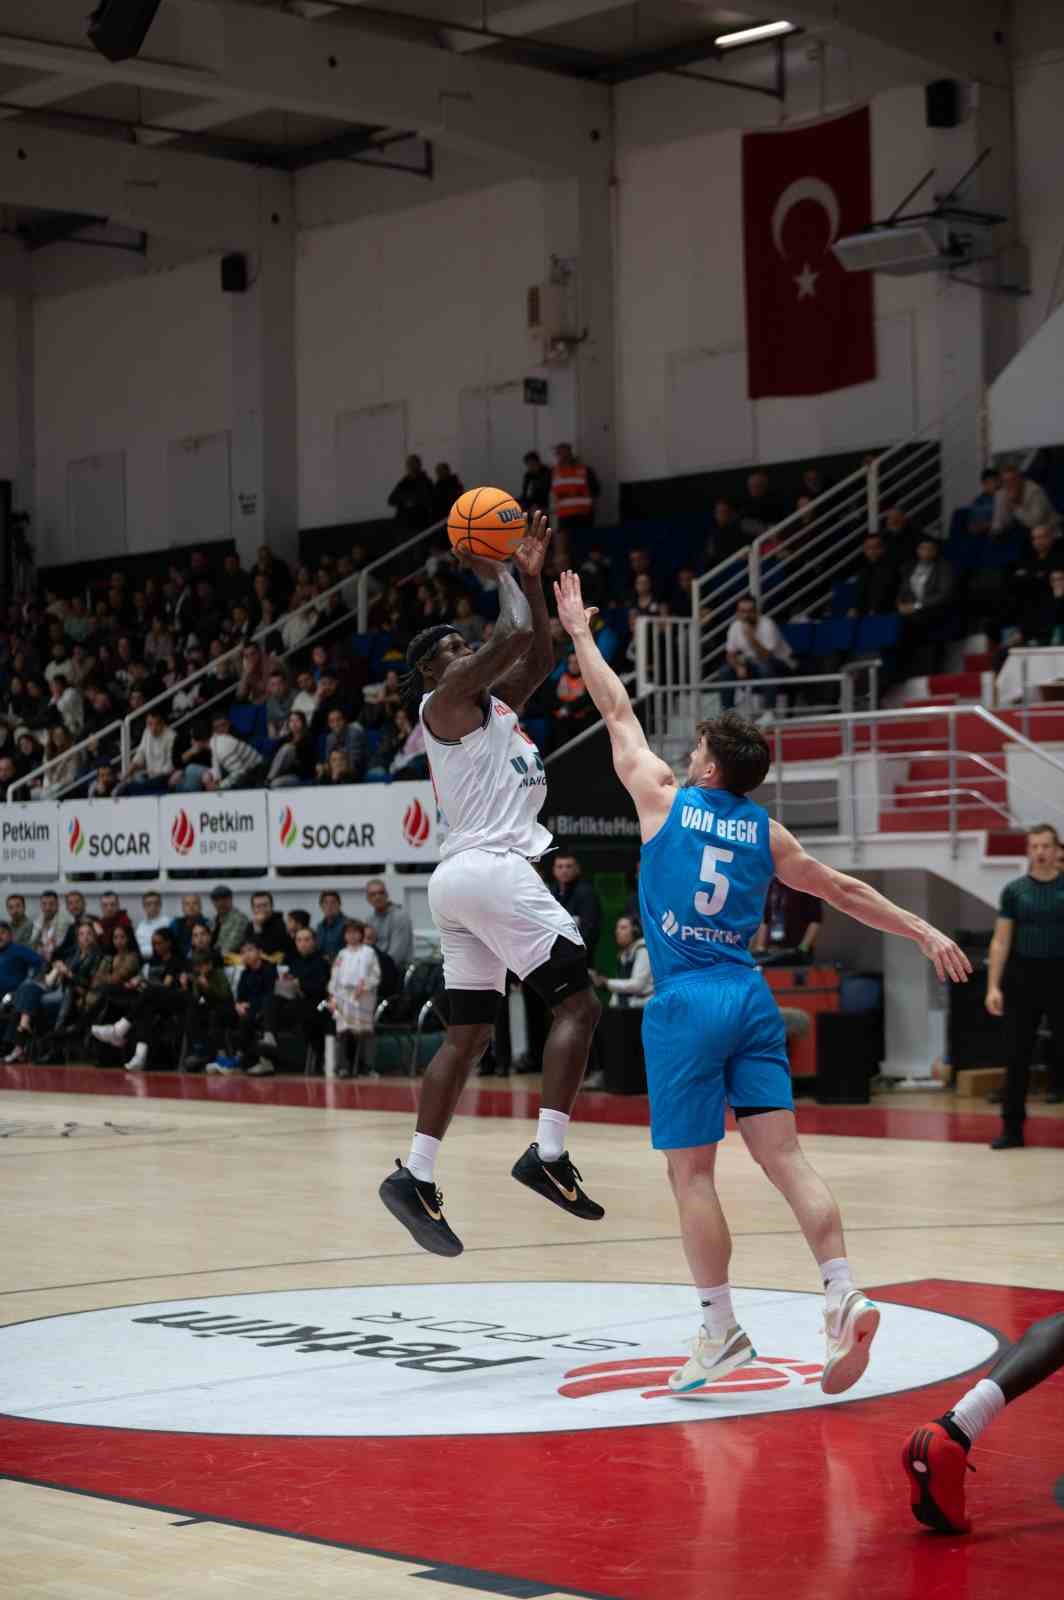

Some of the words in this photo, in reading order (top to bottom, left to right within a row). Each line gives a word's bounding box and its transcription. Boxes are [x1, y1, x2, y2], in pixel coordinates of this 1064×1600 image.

[2, 821, 50, 841] Petkim
[200, 810, 254, 832] Petkim
[302, 823, 375, 849] SOCAR
[681, 805, 714, 833] VAN
[717, 818, 758, 844] BECK
[89, 833, 150, 857] SOCAR
[694, 844, 734, 916] 5
[131, 1309, 545, 1374] Petkim
[352, 1311, 641, 1352] SPOR
